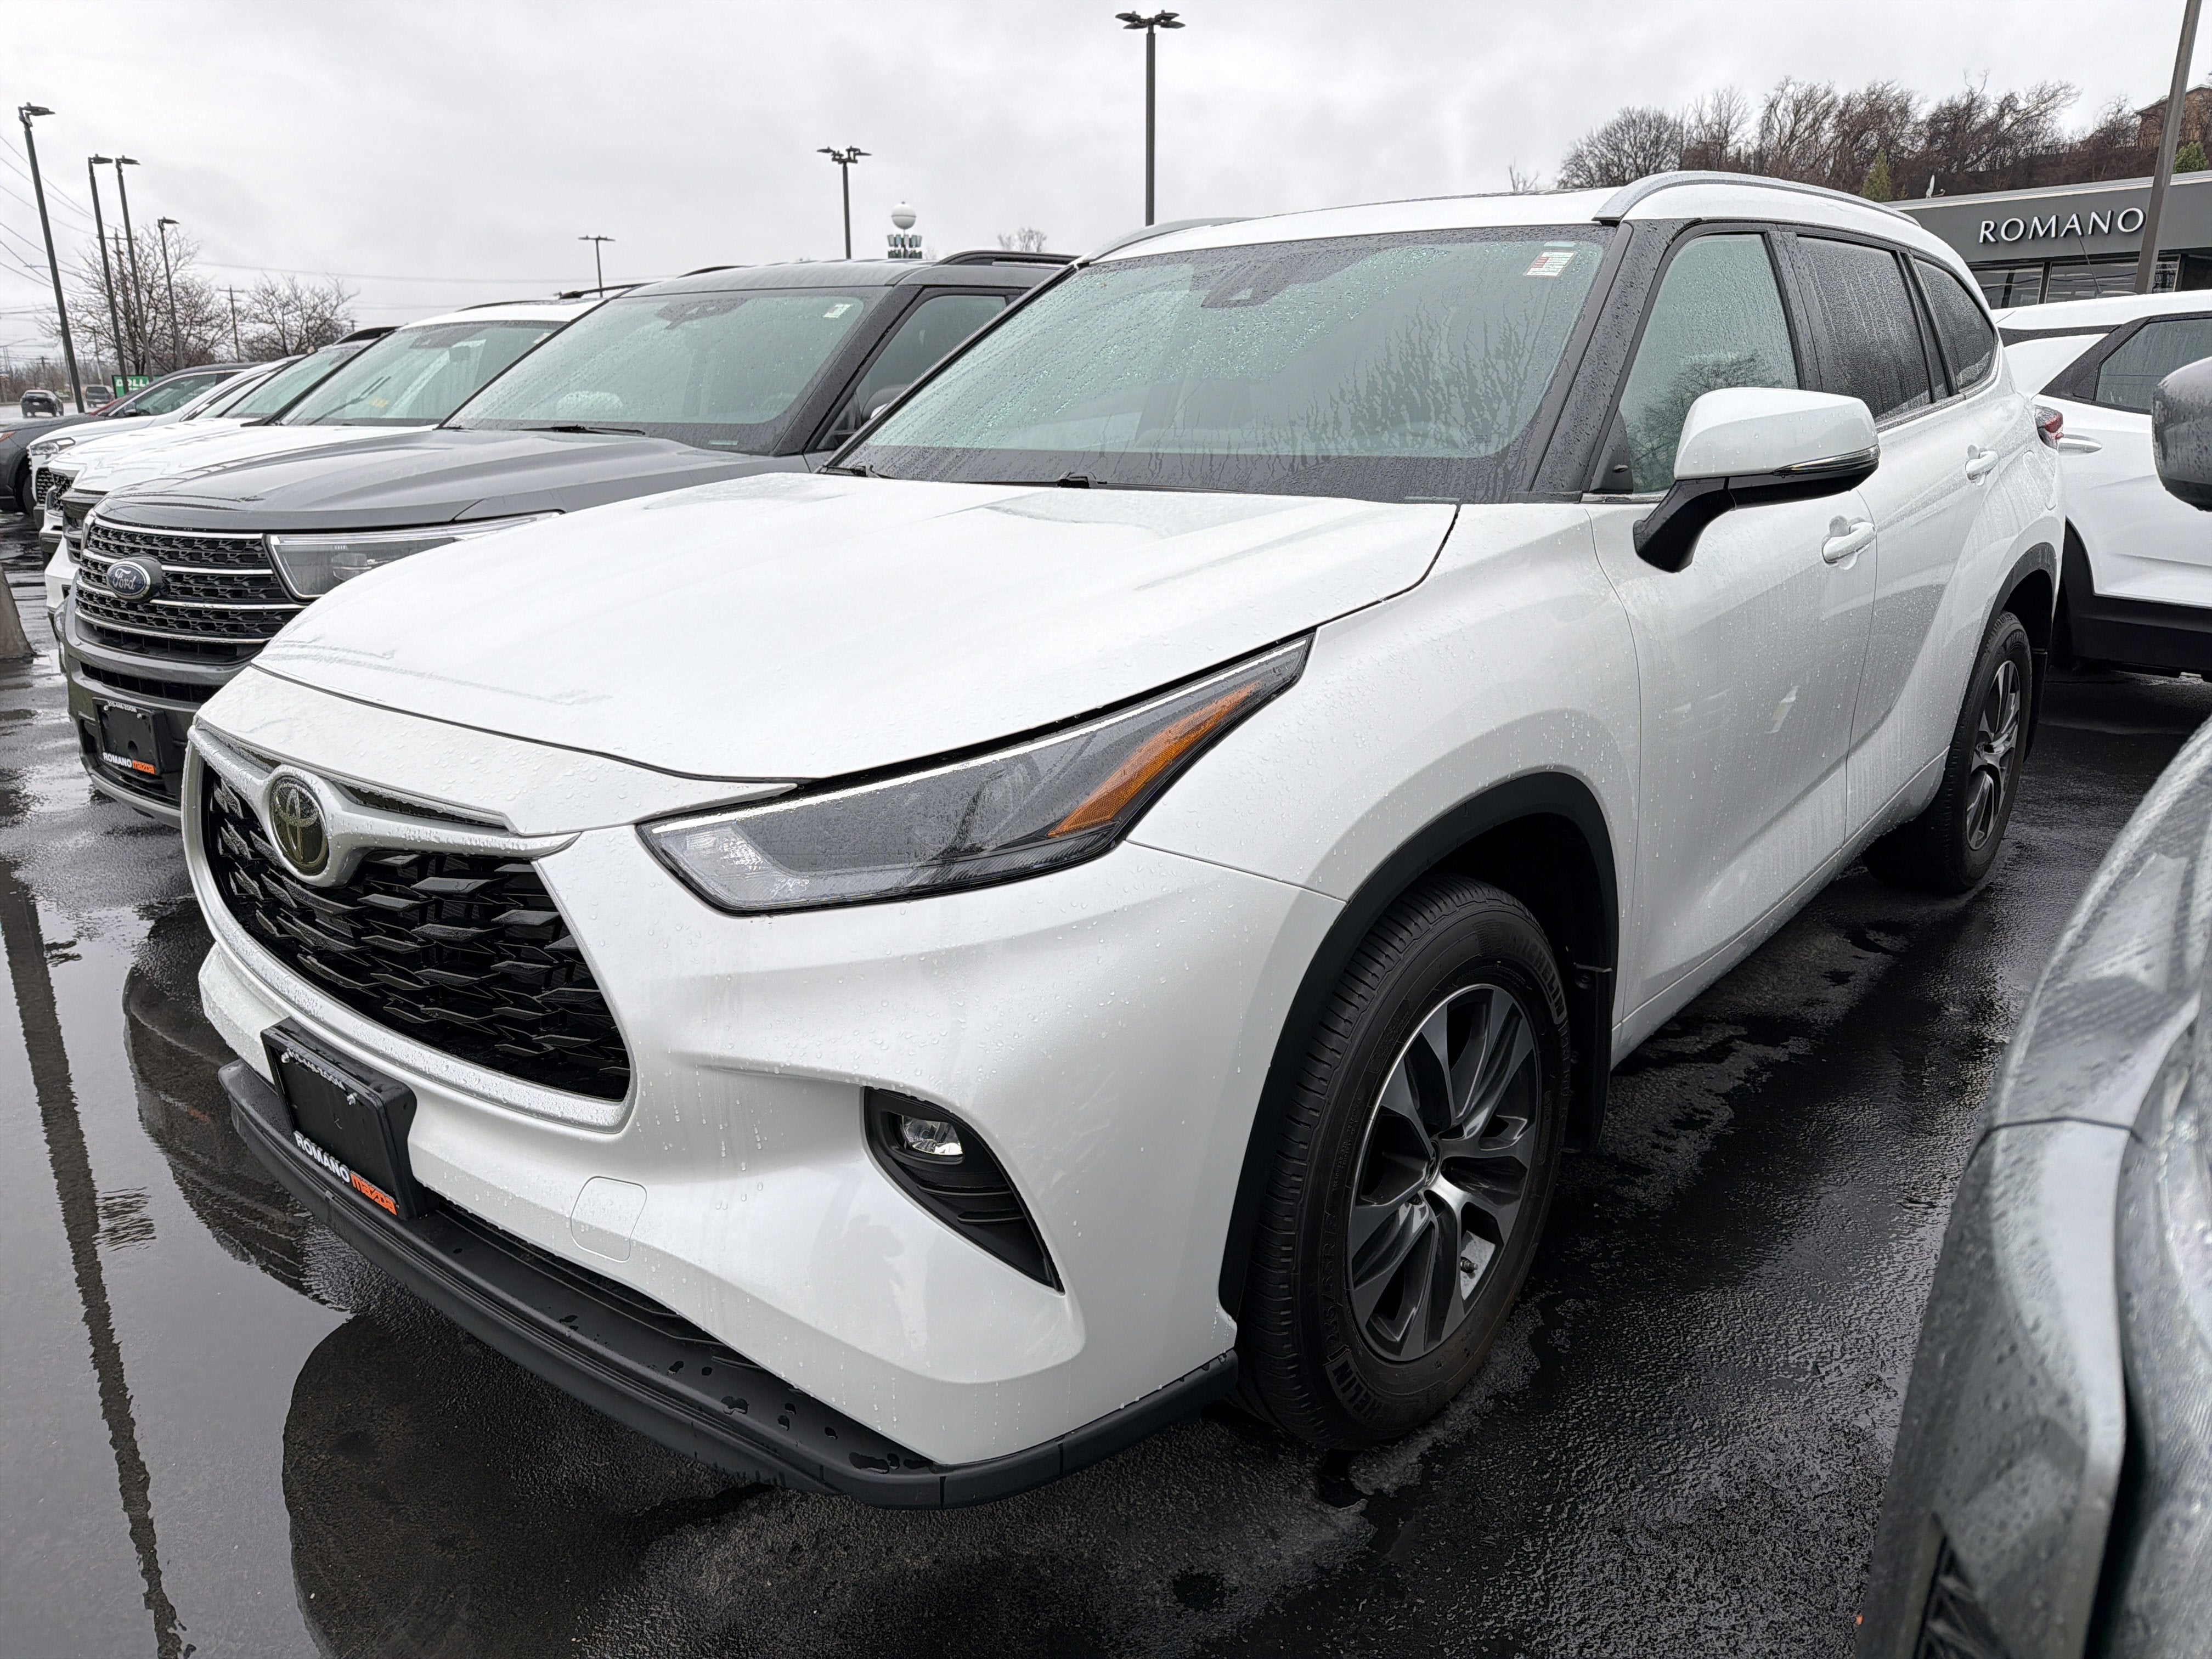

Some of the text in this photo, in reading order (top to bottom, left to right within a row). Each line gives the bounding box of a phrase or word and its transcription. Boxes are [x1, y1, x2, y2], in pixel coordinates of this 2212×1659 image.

[1979, 207, 2146, 244] ROMANO
[116, 379, 150, 387] DOLL
[112, 568, 137, 590] Ford
[103, 752, 132, 768] ROMANO
[293, 1131, 351, 1183] ROMANO
